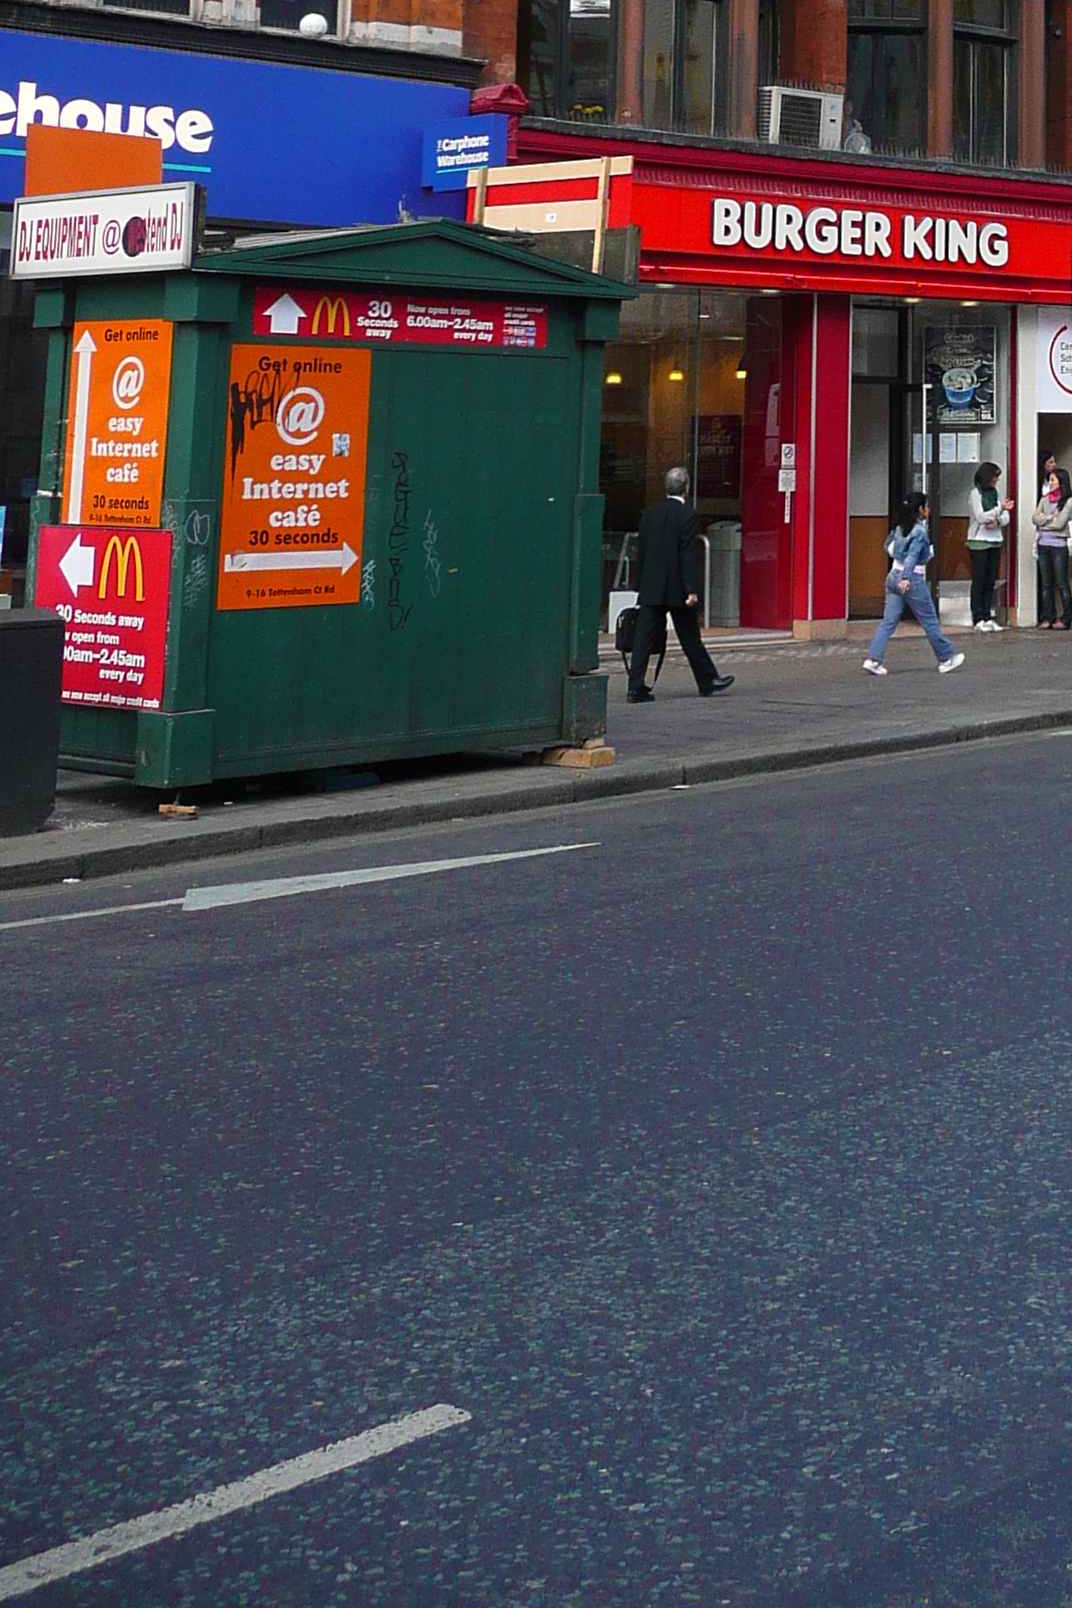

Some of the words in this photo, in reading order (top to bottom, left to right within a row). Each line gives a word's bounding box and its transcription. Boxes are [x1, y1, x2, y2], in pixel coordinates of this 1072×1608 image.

[442, 135, 489, 152] Carphone
[437, 151, 489, 167] Warehouse
[18, 220, 34, 262] DJ
[34, 214, 99, 262] EQUIPMENT
[712, 198, 892, 258] BURGER
[903, 214, 1009, 267] KING
[367, 300, 392, 318] 30
[407, 304, 425, 314] Now
[427, 305, 449, 316] open
[450, 306, 471, 316] from
[357, 316, 398, 329] Seconds
[104, 328, 124, 342] Get
[126, 327, 159, 341] online
[365, 327, 392, 340] away
[453, 330, 475, 342] every
[477, 331, 493, 343] day
[258, 356, 288, 373] Get
[293, 357, 343, 374] online
[108, 416, 144, 436] easy
[91, 437, 159, 458] Internet
[106, 462, 140, 483] café
[270, 454, 326, 475] easy
[242, 477, 349, 500] Internet
[93, 495, 106, 509] 30
[108, 495, 149, 510] seconds
[268, 504, 321, 528] café
[249, 529, 270, 546] 30
[274, 528, 339, 545] seconds
[246, 587, 267, 598] 9-16
[268, 587, 312, 598] Tottenham
[324, 585, 335, 595] Rd
[74, 609, 116, 626] Seconds
[118, 615, 144, 631] away
[72, 632, 94, 644] open
[97, 631, 120, 645] from
[99, 668, 124, 683] every
[126, 669, 144, 685] day
